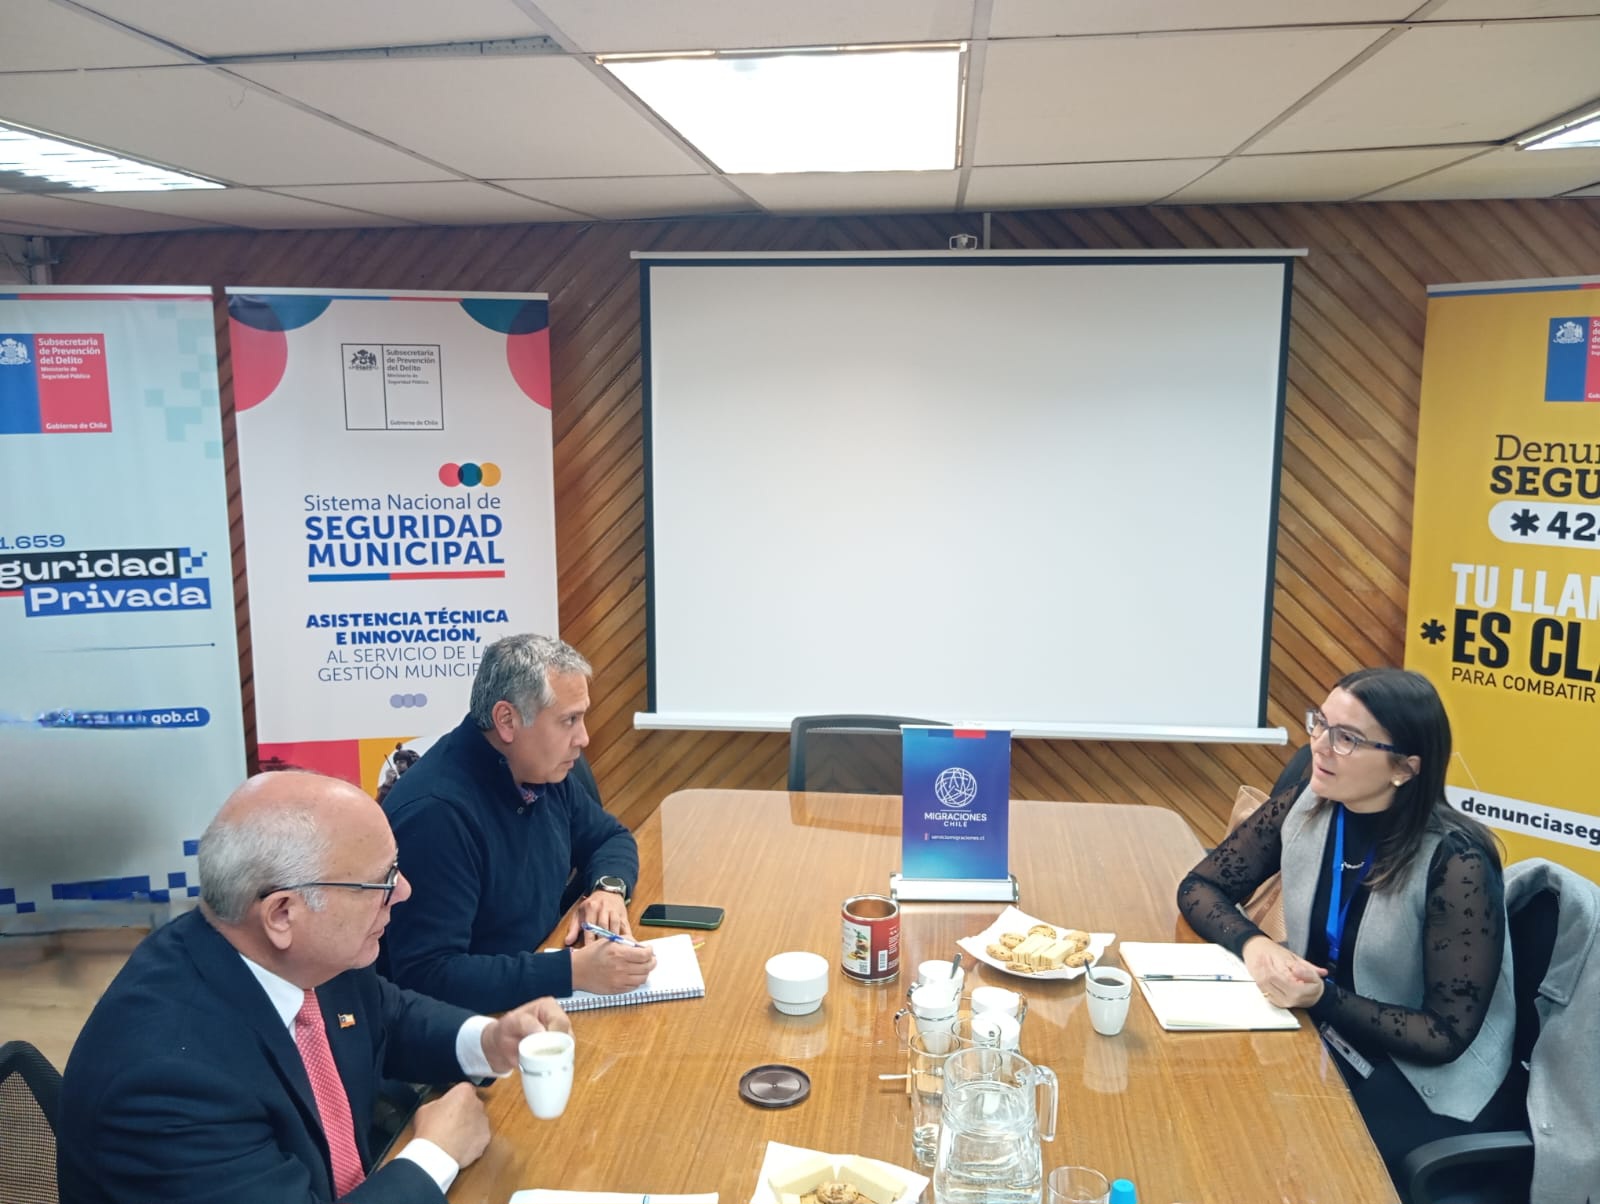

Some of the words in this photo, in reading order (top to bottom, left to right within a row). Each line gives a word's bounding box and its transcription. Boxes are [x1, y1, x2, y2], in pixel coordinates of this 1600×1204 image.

[39, 347, 50, 355] de
[51, 346, 101, 355] Prevención
[40, 356, 54, 364] del
[55, 356, 83, 364] Delito
[1490, 465, 1600, 499] SEGU
[304, 494, 381, 511] Sistema
[388, 493, 471, 510] Nacional
[477, 492, 501, 509] de
[305, 514, 502, 541] SEGURIDAD
[308, 540, 504, 567] MUNICIPAL
[0, 551, 175, 589] guridad
[30, 582, 207, 612] Privada
[1451, 562, 1500, 608] TU
[306, 611, 422, 628] ASISTENCIA
[425, 607, 509, 625] TÉCNICA
[336, 632, 347, 645] E
[351, 625, 481, 645] INNOVACIÓN,
[327, 650, 348, 663] AL
[354, 647, 437, 662] SERVICIO
[443, 646, 466, 659] DE
[1529, 617, 1600, 684] CL
[318, 663, 399, 681] GESTIÓN
[1451, 667, 1497, 688] PARA
[1503, 675, 1596, 703] COMBATIR
[924, 812, 987, 821] MIGRACIONES
[1461, 797, 1600, 845] denunciaseg
